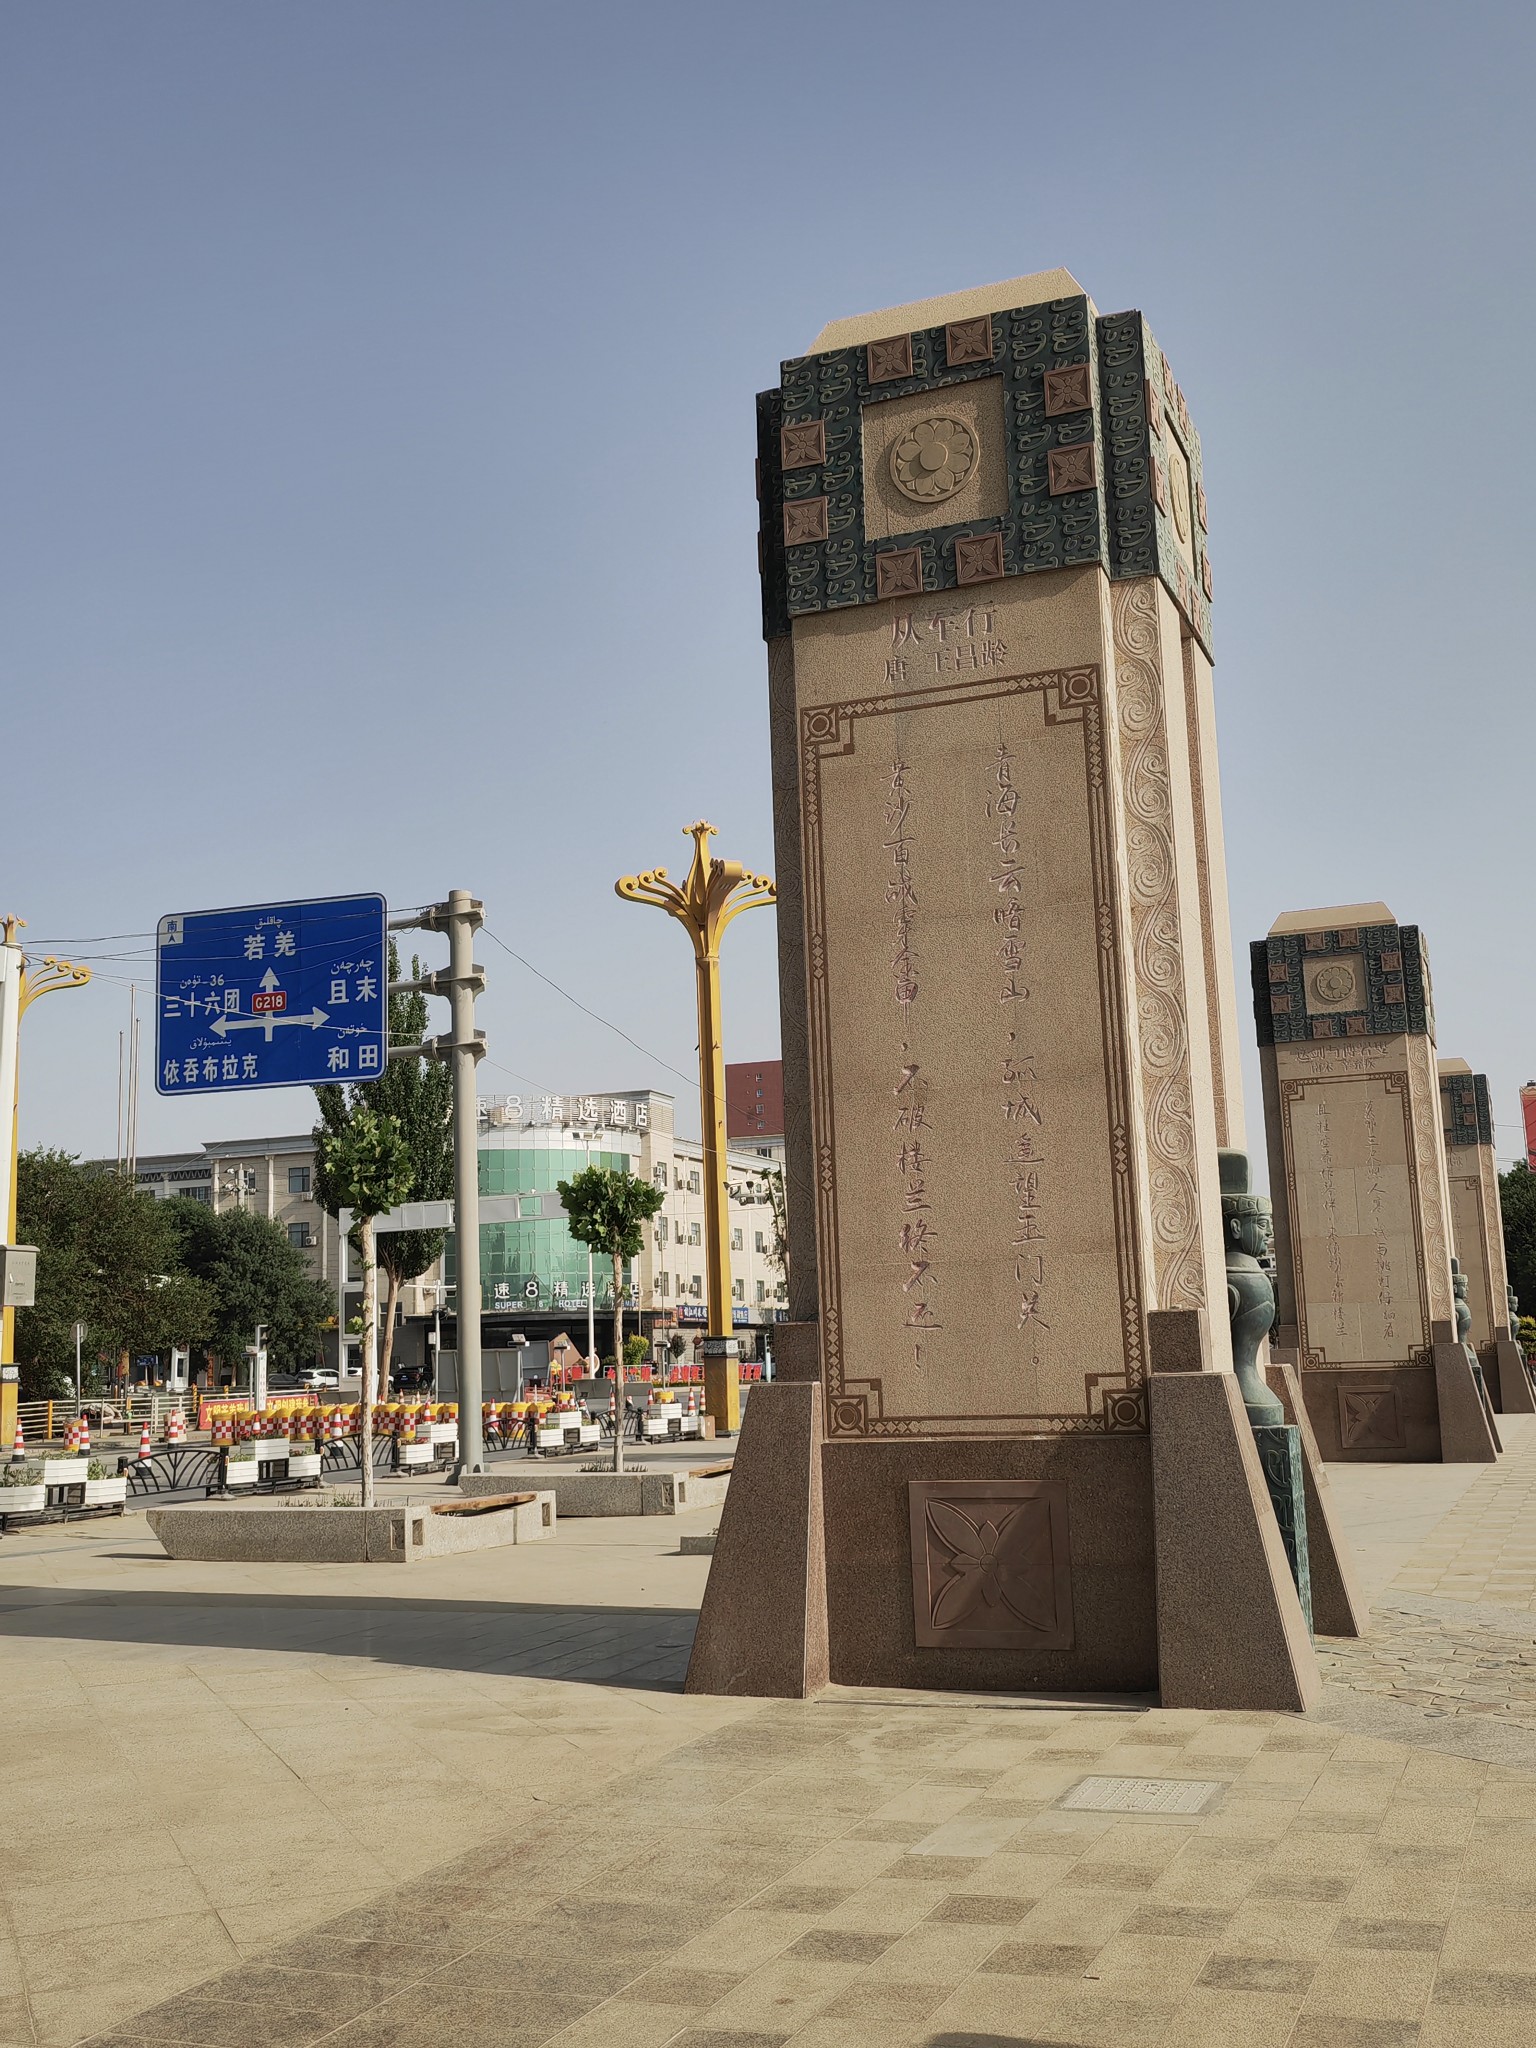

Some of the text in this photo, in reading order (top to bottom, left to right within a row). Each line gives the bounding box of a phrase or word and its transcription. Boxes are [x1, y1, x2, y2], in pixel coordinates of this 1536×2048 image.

[888, 601, 998, 650] 从军行
[882, 638, 1009, 685] 唐 王昌龄
[167, 919, 178, 933] 南
[243, 930, 297, 961] 若羌
[330, 958, 375, 975] چەرچەن
[163, 988, 240, 1018] 三十六团
[255, 994, 284, 1009] G218
[327, 975, 378, 1005] 且末
[163, 1052, 258, 1086] 依吞布拉克
[326, 1044, 378, 1073] 和田
